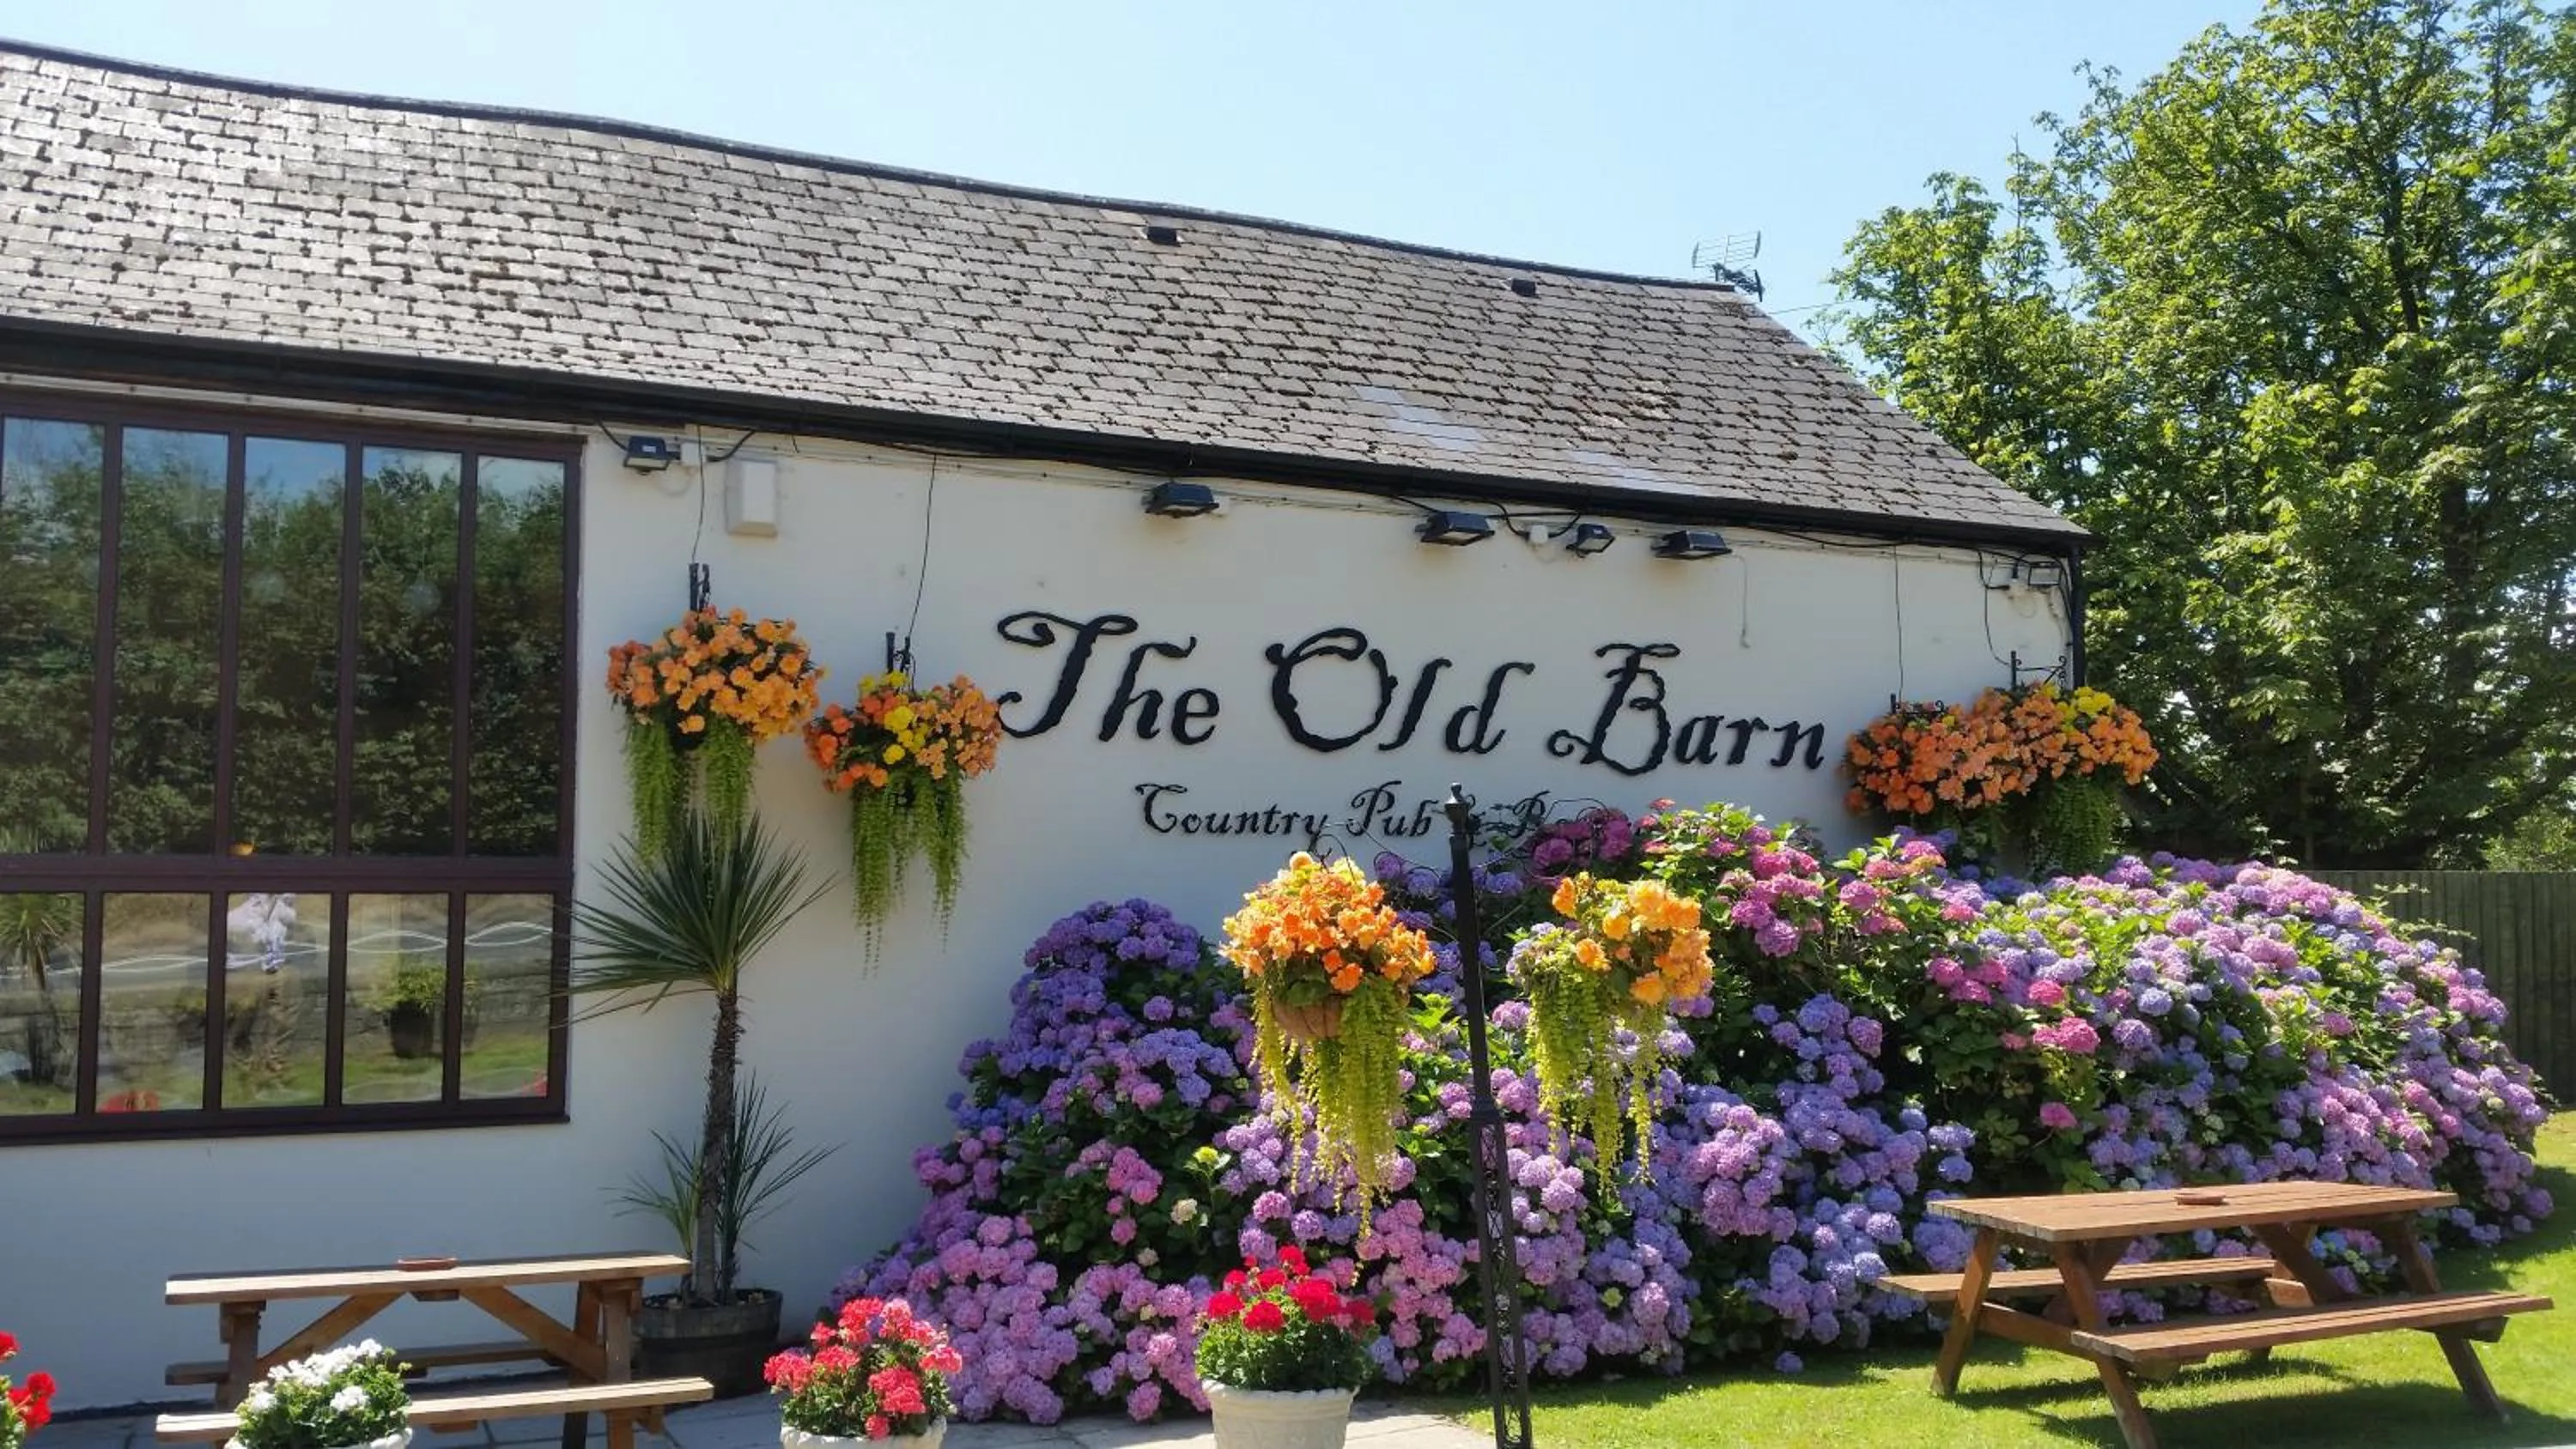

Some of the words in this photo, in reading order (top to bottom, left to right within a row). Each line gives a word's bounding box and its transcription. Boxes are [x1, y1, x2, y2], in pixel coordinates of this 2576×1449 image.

[994, 609, 1221, 745] The
[1264, 627, 1536, 755] Old
[1546, 642, 1826, 777] Barn
[1134, 782, 1333, 857] Country
[1344, 779, 1440, 838] Pub
